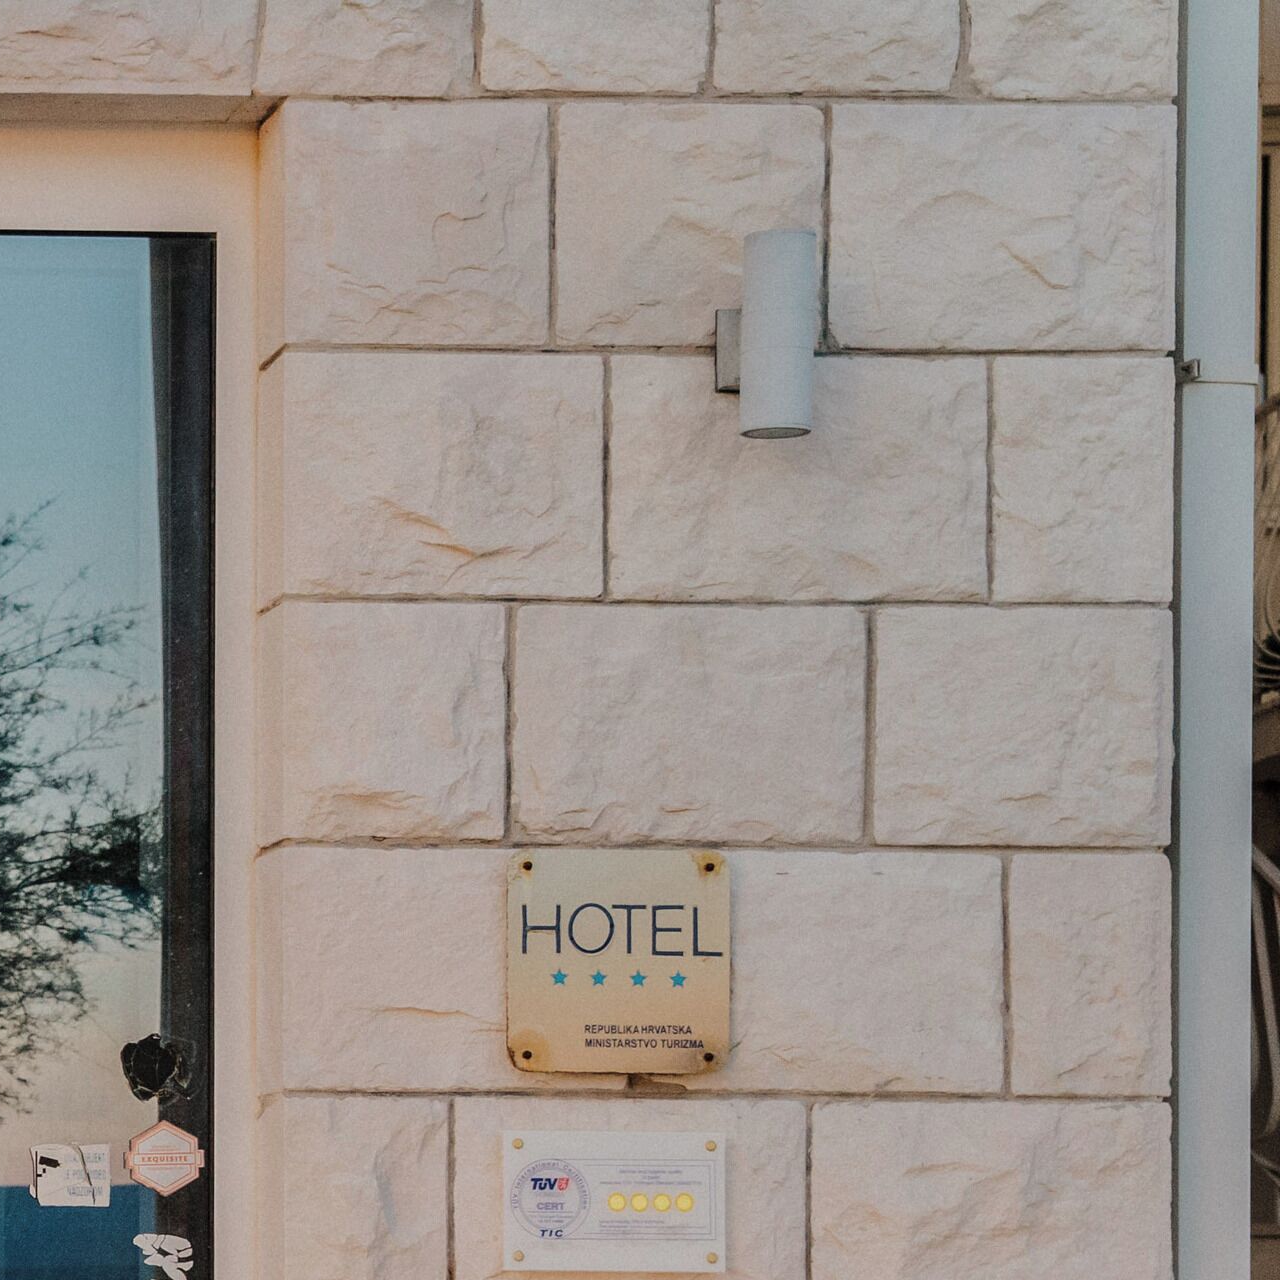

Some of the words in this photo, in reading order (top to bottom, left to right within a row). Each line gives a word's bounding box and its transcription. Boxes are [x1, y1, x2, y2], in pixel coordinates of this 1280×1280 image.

[521, 903, 723, 957] HOTEL
[584, 1024, 639, 1035] REPUBLIKA
[641, 1025, 692, 1035] HRVATSKA
[584, 1038, 658, 1048] MINISTARSTVO
[661, 1039, 704, 1049] TURIZMA
[141, 1155, 188, 1163] EXQUISITE
[536, 1202, 566, 1211] CERT
[540, 1229, 564, 1238] TIC
